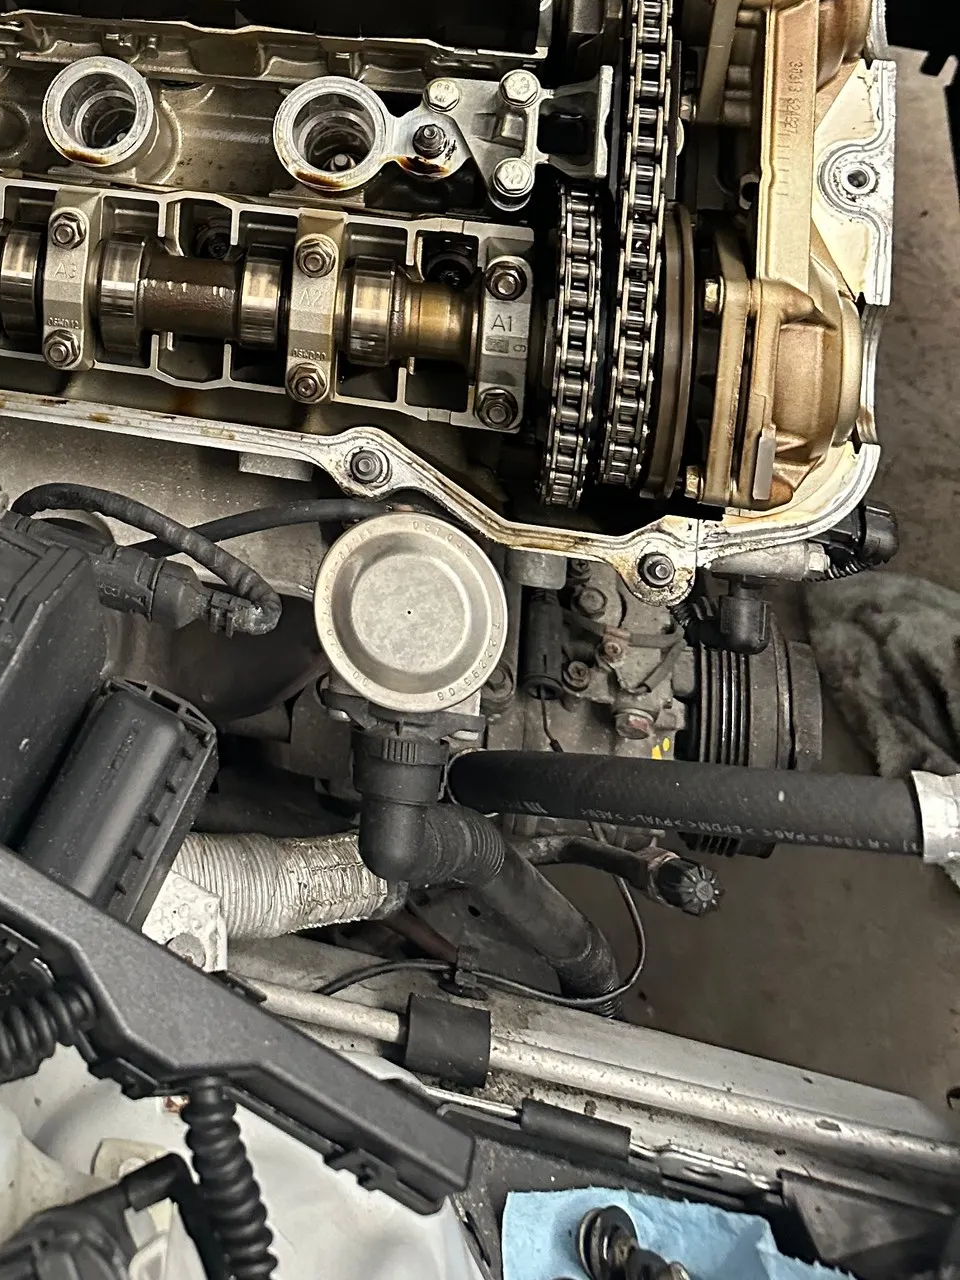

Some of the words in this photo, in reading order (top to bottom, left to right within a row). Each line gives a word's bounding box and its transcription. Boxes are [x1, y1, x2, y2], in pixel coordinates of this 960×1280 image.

[53, 262, 78, 280] A3
[299, 286, 322, 307] A2
[490, 313, 513, 333] A1
